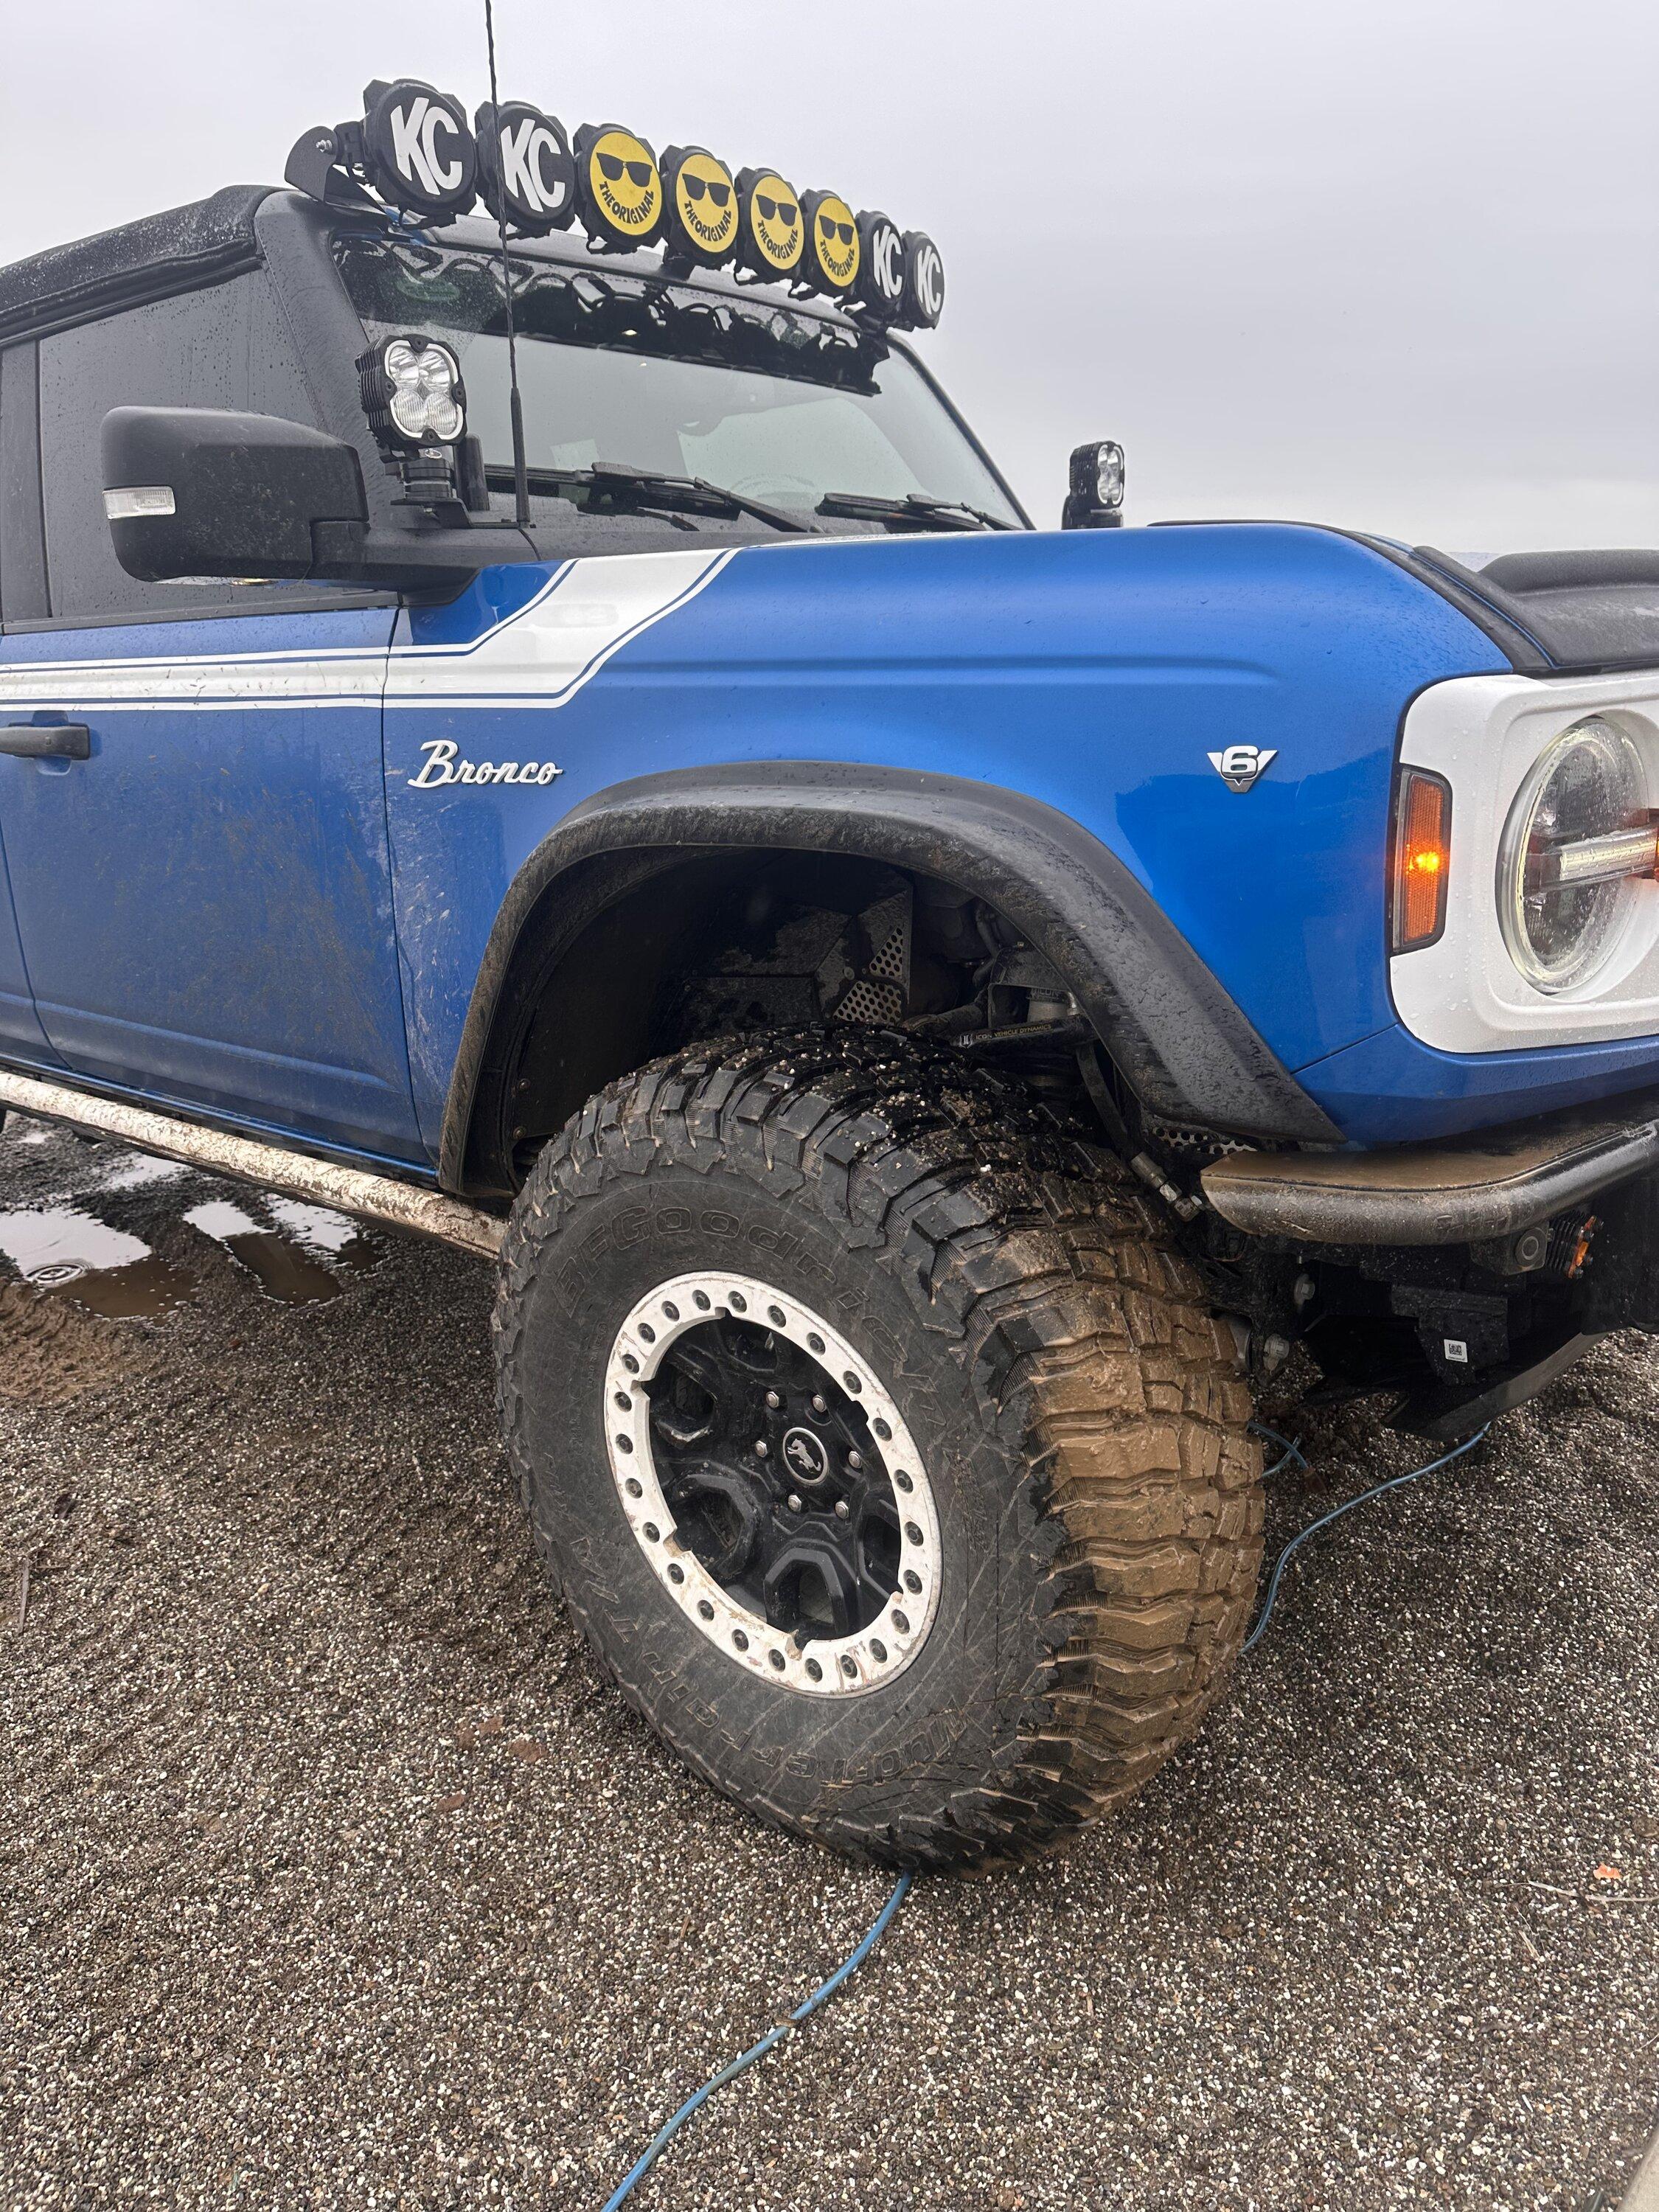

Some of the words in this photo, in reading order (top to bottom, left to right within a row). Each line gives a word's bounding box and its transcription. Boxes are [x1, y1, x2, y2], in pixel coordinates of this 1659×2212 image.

[390, 97, 462, 195] KC
[501, 119, 565, 212] KC
[599, 181, 616, 208] THE
[611, 189, 654, 224] ORIGINAL
[684, 201, 698, 226] THE
[695, 210, 731, 242] ORIGINAL
[767, 229, 798, 259] ORIGINAL
[872, 225, 902, 299] KC
[917, 246, 942, 315] KC
[407, 740, 563, 788] Bronco
[1020, 1024, 1051, 1034] DYNAMICS
